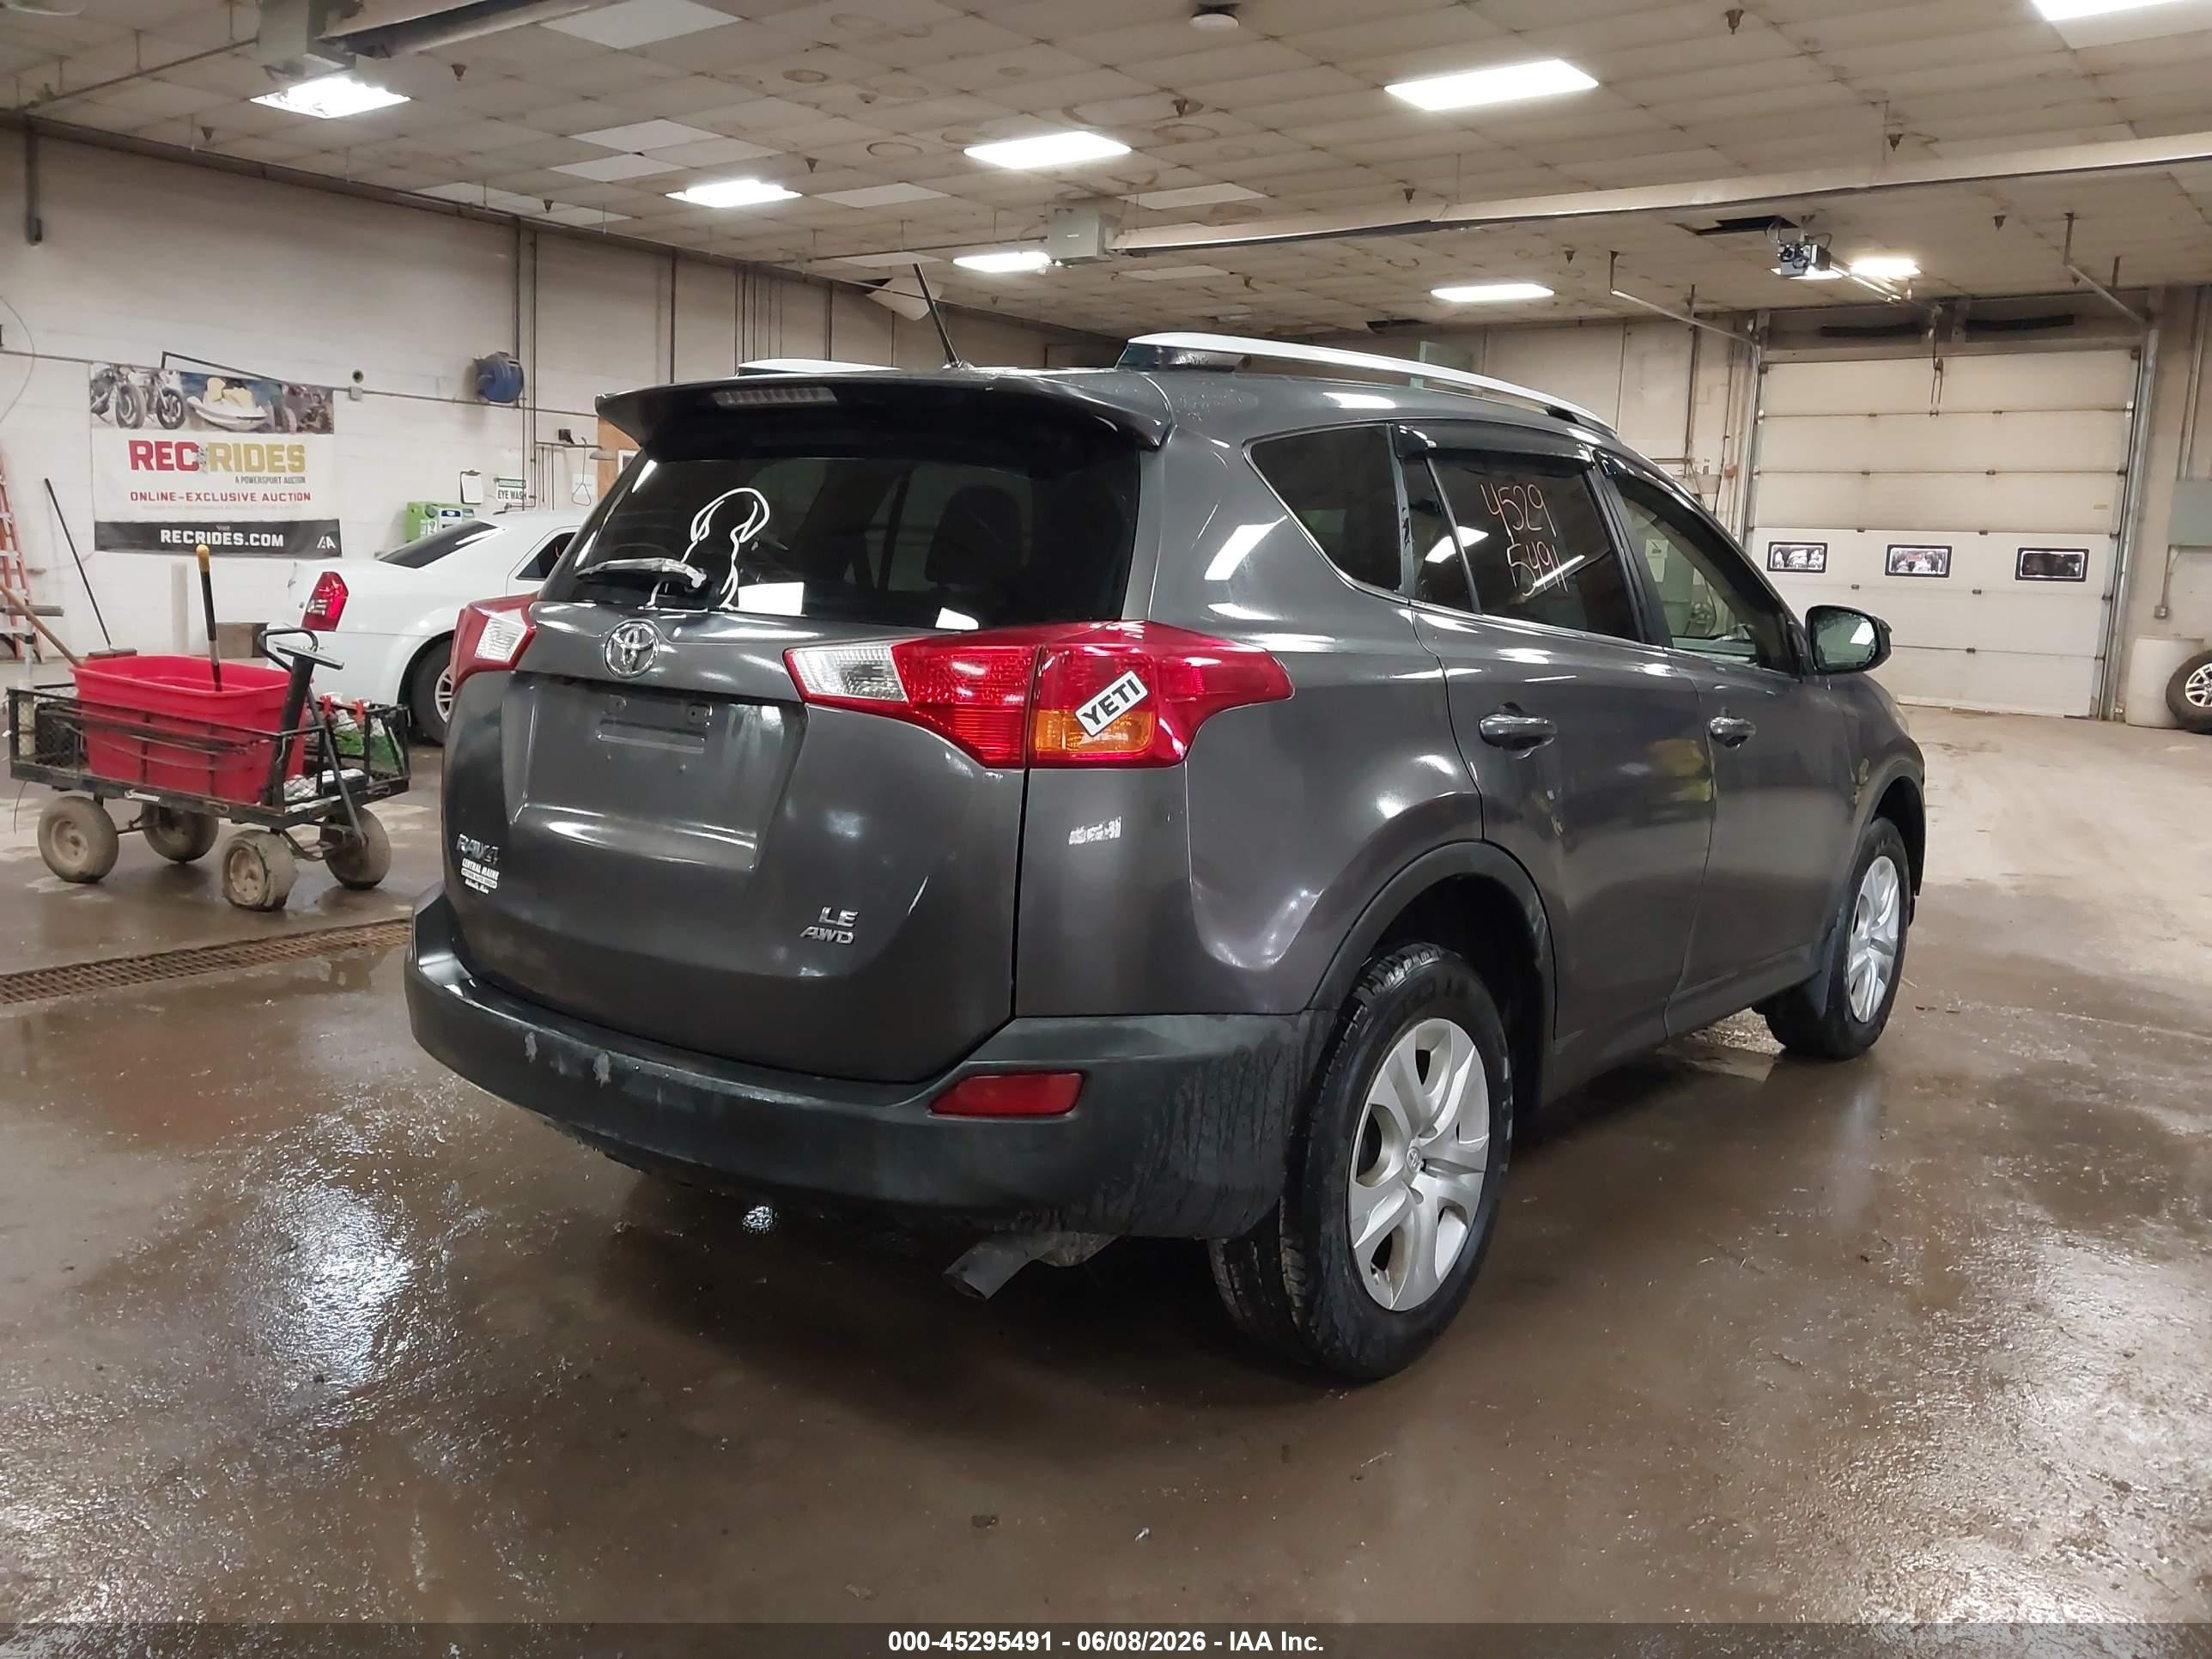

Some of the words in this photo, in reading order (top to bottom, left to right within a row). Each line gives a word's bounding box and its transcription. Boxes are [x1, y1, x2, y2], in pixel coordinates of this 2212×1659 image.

[128, 440, 200, 472] REC
[207, 442, 307, 473] RIDES
[234, 476, 240, 484] A
[240, 476, 282, 484] POWERSPORT
[130, 491, 258, 502] ONLINE-EXCLUSIVE
[261, 492, 312, 502] AUCTION
[498, 489, 508, 500] EYE
[1480, 483, 1557, 545] 4529
[160, 528, 284, 548] RECRIDES.COM
[1506, 541, 1568, 596] 5491
[1080, 678, 1141, 726] YETI
[456, 833, 500, 866] RAV4
[818, 906, 859, 927] LE
[799, 926, 854, 945] AWD
